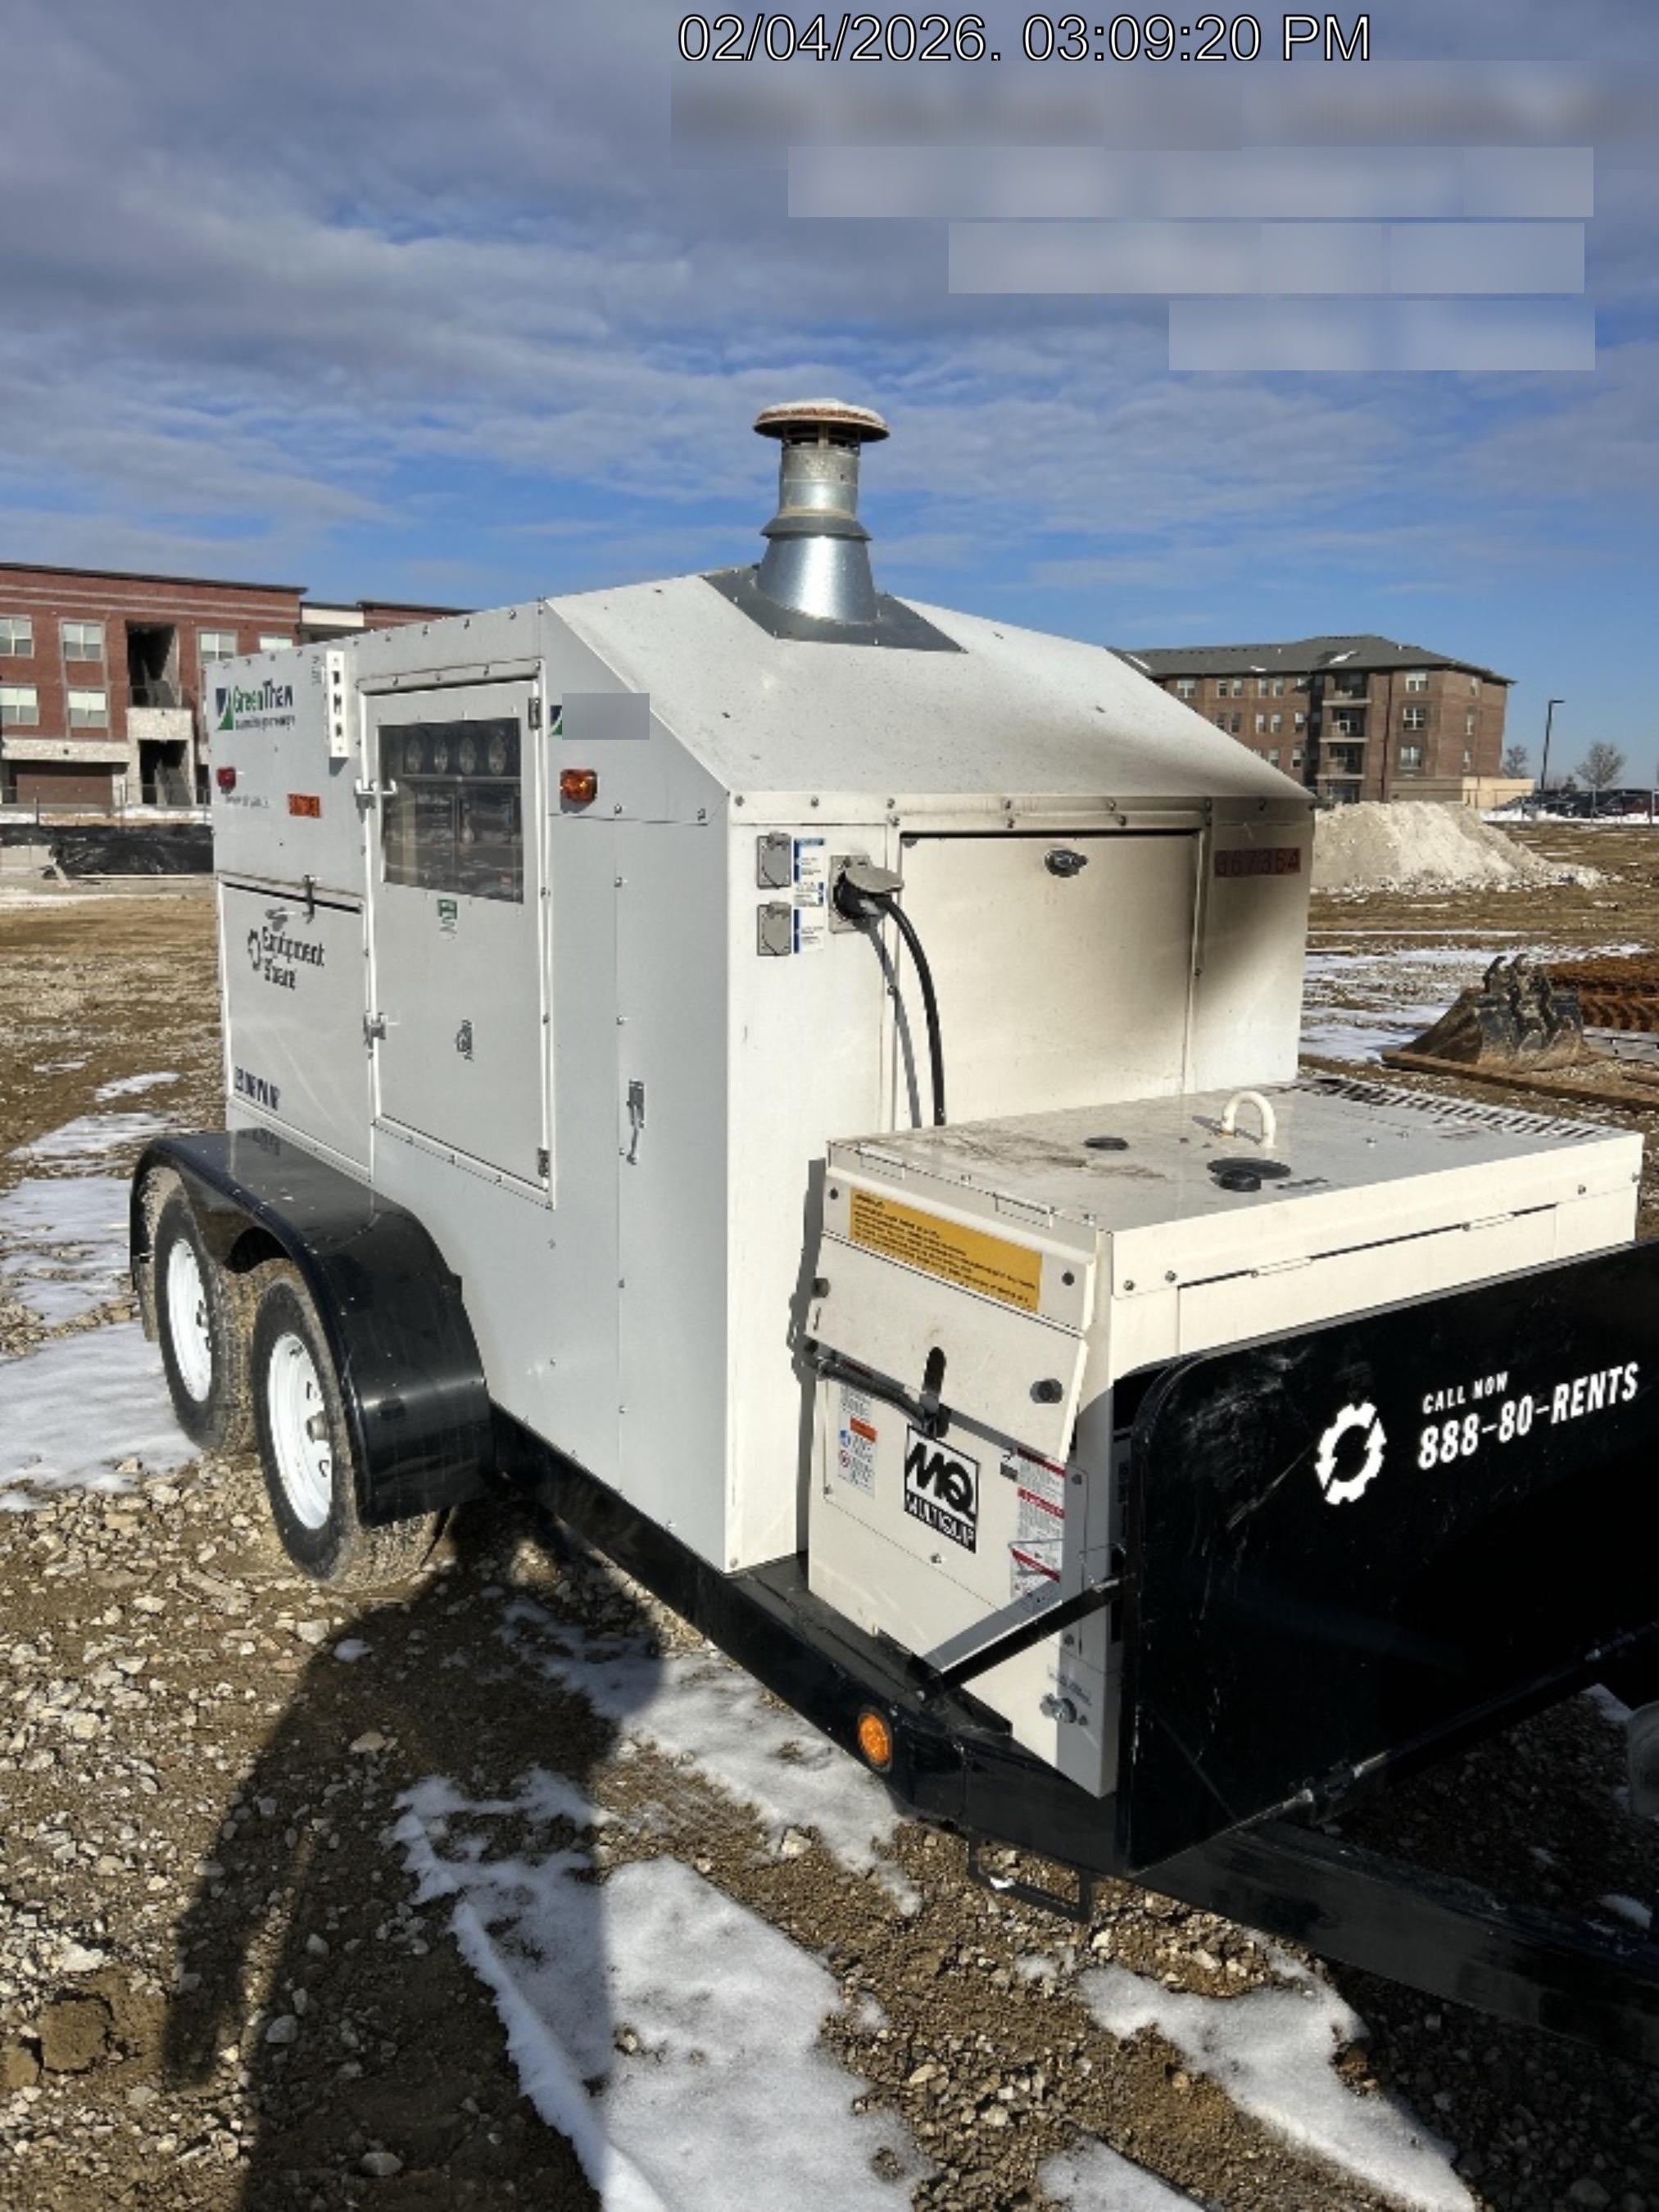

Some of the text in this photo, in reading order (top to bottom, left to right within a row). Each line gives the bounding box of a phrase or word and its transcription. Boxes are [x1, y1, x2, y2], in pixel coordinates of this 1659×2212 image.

[1417, 1361, 1639, 1471] 888-80-RENTS
[1422, 1371, 1509, 1415] CALL NOW
[907, 1442, 973, 1521] MQ
